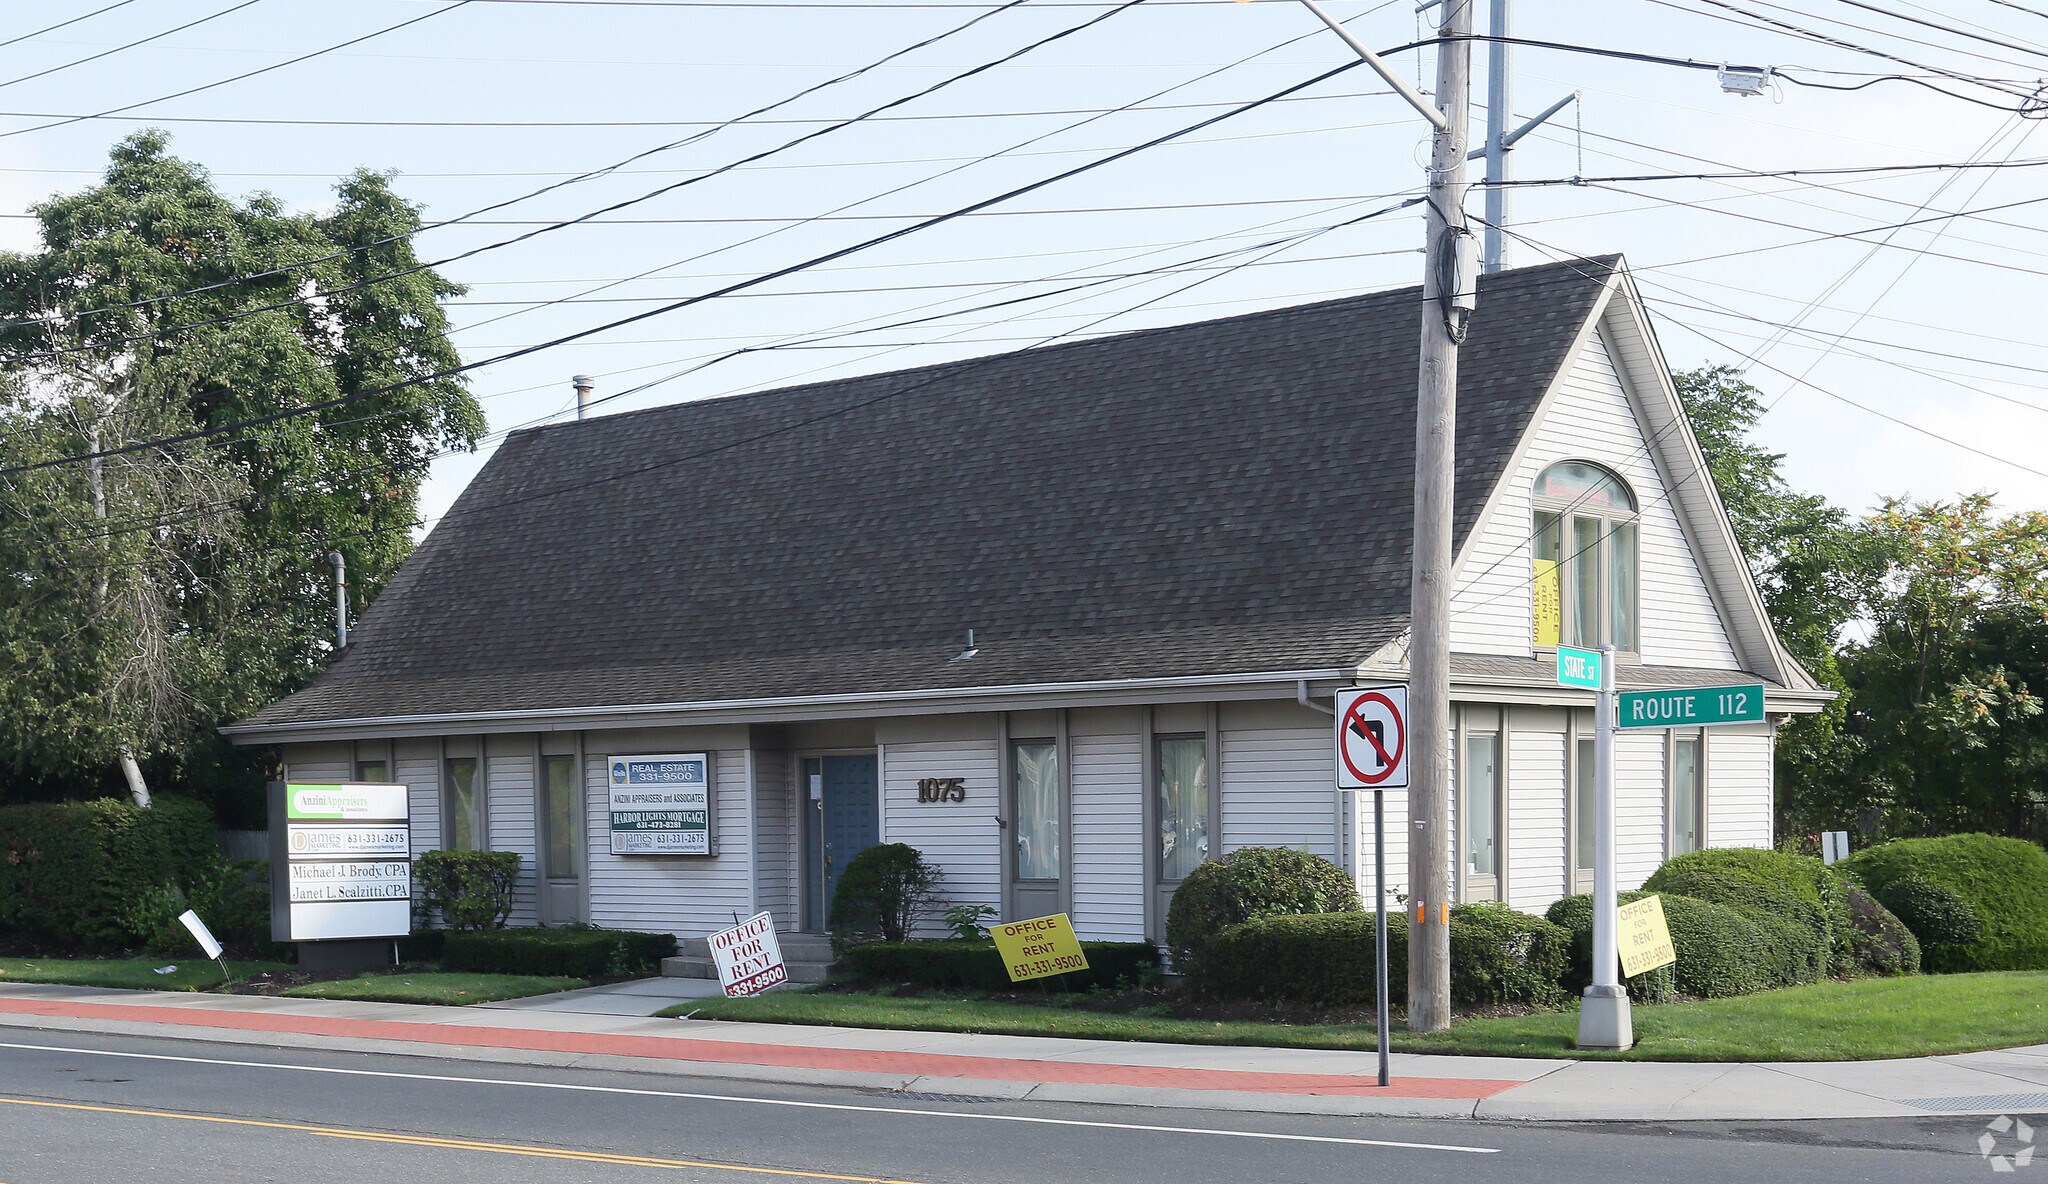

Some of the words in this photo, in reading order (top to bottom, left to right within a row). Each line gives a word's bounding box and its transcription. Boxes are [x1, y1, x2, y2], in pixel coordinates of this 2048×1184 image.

[1564, 655, 1586, 679] STATE
[1587, 666, 1595, 680] ST
[1632, 696, 1696, 720] ROUTE
[1718, 692, 1747, 716] 112
[632, 764, 657, 772] REAL
[660, 763, 695, 772] ESTATE
[639, 772, 692, 781] 331-9500
[917, 777, 965, 803] 1075
[614, 794, 631, 804] ANZINI
[632, 794, 663, 803] APPRAISERS
[673, 793, 705, 803] ASSOCIATES
[613, 812, 641, 824] HARBOR
[642, 812, 666, 821] LIGHTS
[667, 811, 705, 823] MORTGAGE
[347, 833, 405, 844] 631-331-2675
[657, 833, 705, 844] 631-331-2675
[293, 865, 336, 878] Michael
[349, 864, 382, 879] Brody,
[384, 864, 407, 877] CPA
[293, 886, 323, 899] Janet
[326, 886, 336, 899] L.
[1620, 901, 1654, 921] OFFICE
[1004, 918, 1057, 936] OFFICE
[1633, 918, 1648, 929] FOR
[716, 917, 769, 949] OFFICE
[1024, 933, 1045, 942] FOR
[1632, 929, 1655, 947] RENT
[731, 938, 763, 961] FOR
[1022, 942, 1056, 957] RENT
[1627, 943, 1672, 972] 631-331-9500
[730, 951, 772, 980] RENT
[1013, 954, 1083, 978] 631-331-9500
